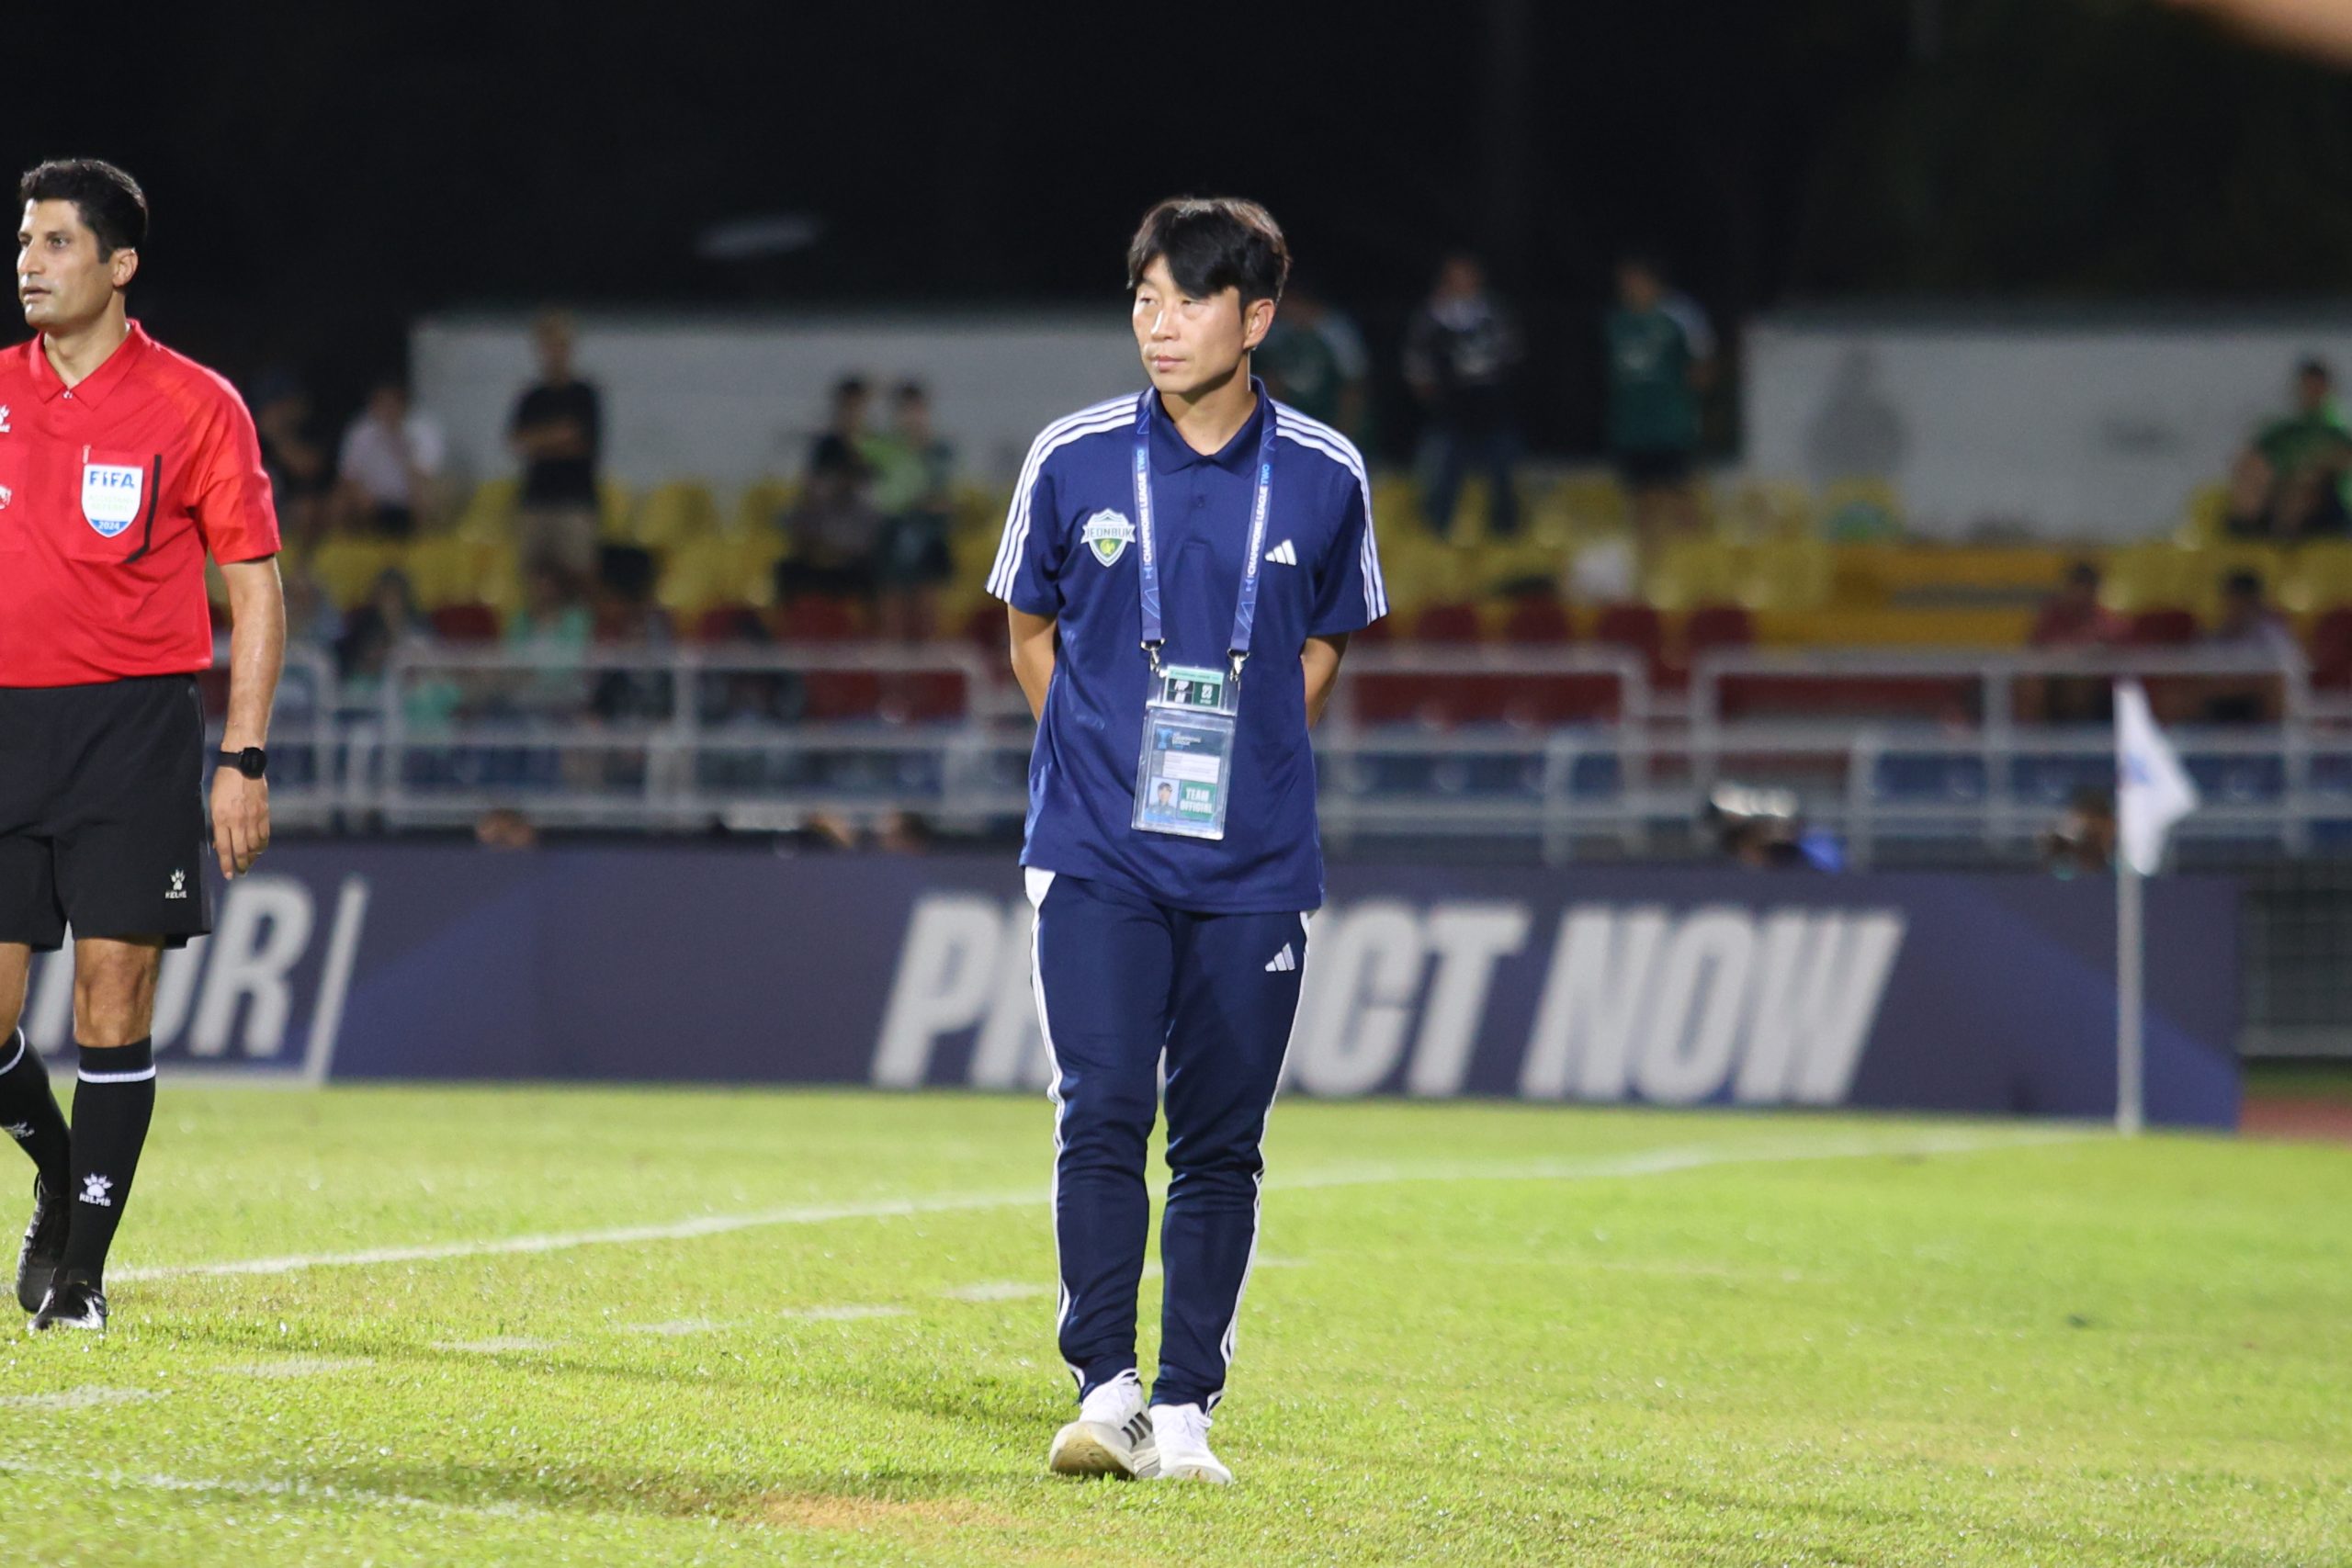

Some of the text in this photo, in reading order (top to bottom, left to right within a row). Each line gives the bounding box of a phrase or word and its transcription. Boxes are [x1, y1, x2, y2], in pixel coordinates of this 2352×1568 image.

[1136, 448, 1147, 471] TWO
[89, 470, 135, 490] FIFA
[1261, 464, 1270, 485] TWO
[1137, 471, 1148, 508] LEAGUE
[1256, 485, 1269, 522] LEAGUE
[98, 522, 119, 530] 2024
[1085, 527, 1133, 539] JEONBUK
[1186, 787, 1210, 802] TEAM
[1180, 799, 1213, 814] OFFICIAL
[1519, 906, 1905, 1108] NOW
